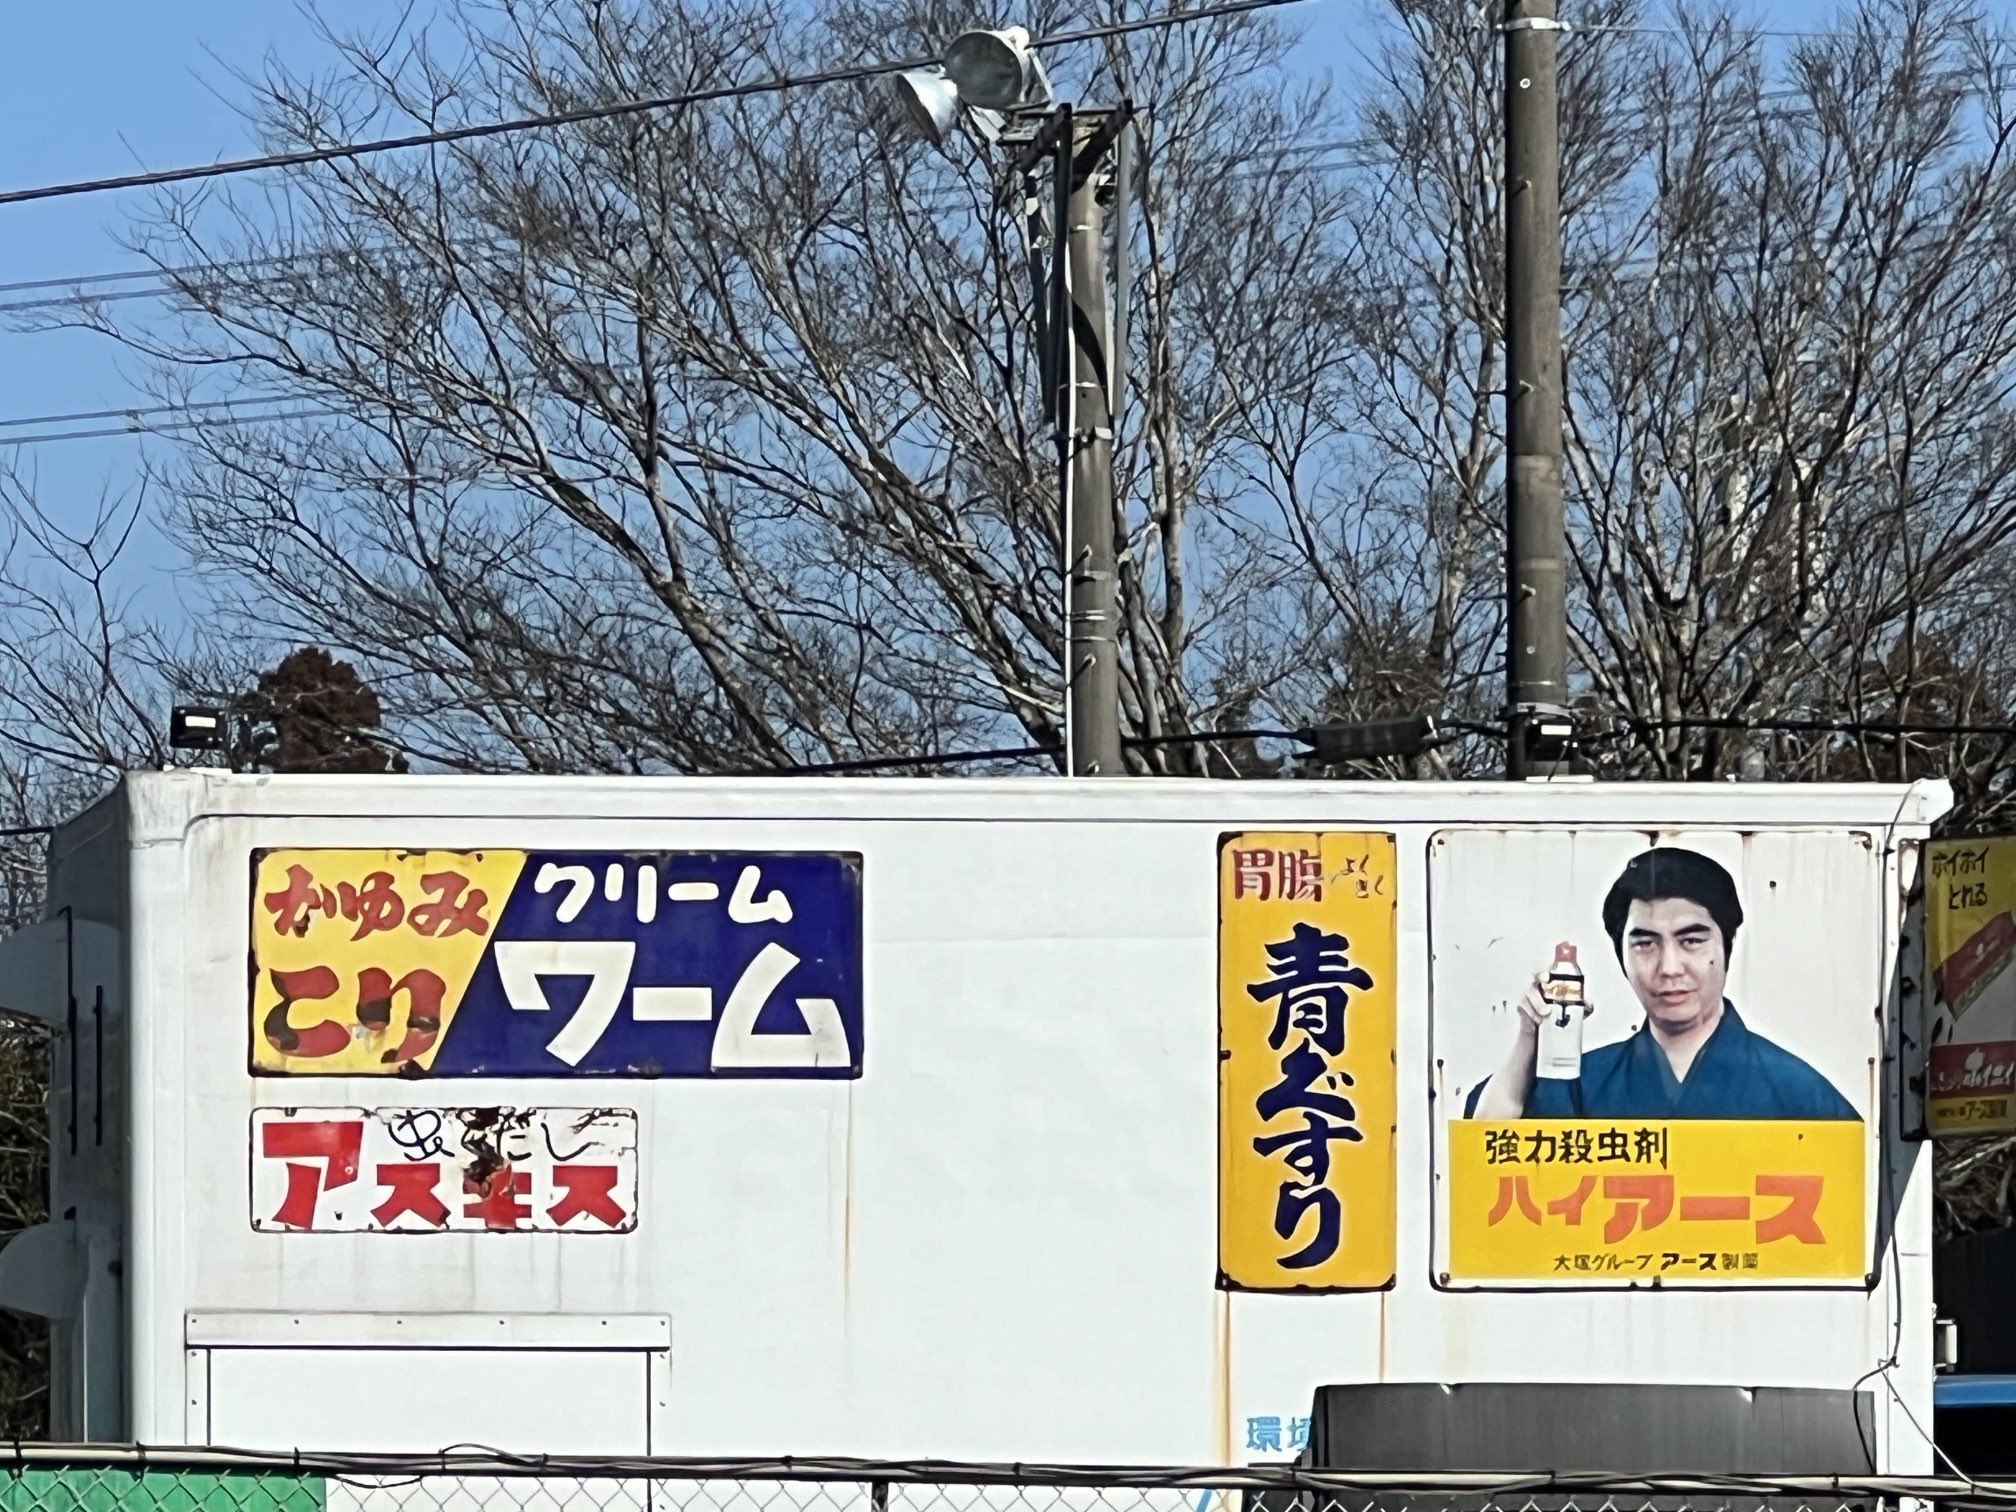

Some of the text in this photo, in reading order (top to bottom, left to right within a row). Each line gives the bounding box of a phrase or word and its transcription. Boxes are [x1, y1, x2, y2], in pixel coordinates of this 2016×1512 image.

[264, 864, 489, 941] かゆみ
[534, 862, 793, 924] クリーム
[264, 966, 447, 1064] こり
[494, 941, 852, 1068] ワーム
[1246, 922, 1374, 1269] 青ぐすり
[1485, 1127, 1668, 1170] 強力殺虫剤
[1488, 1175, 1826, 1245] ハイアース
